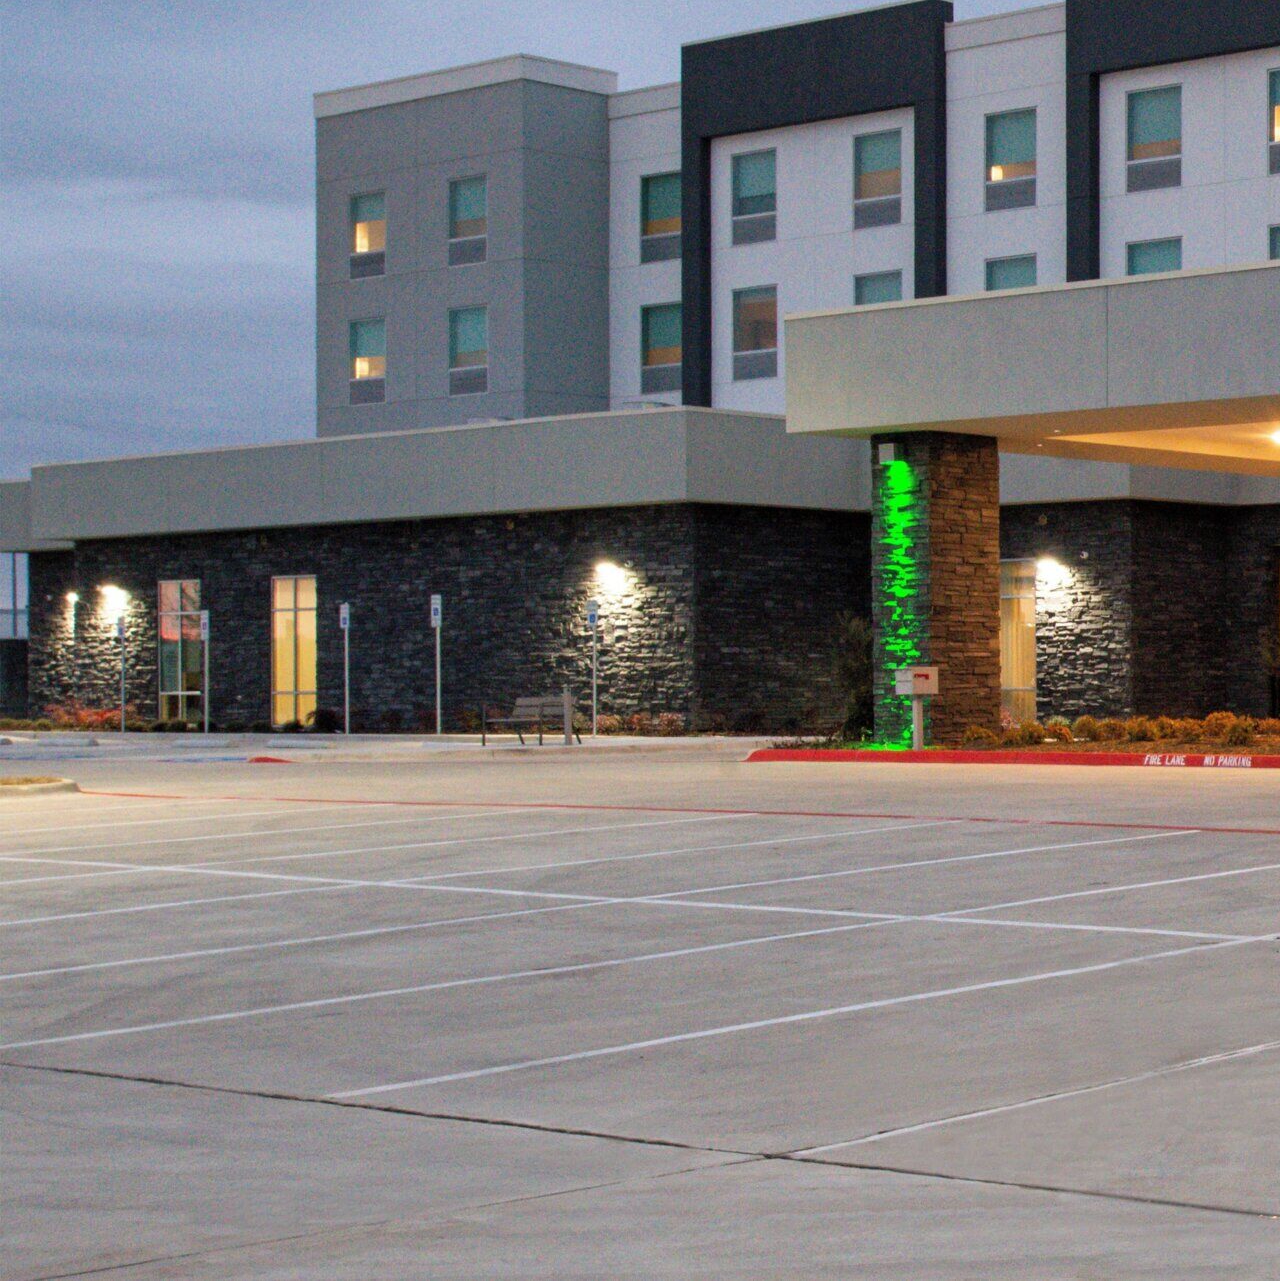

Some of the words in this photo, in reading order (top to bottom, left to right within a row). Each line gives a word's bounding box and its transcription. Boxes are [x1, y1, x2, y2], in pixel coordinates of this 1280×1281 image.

[1144, 754, 1163, 765] FIRE
[1165, 755, 1187, 766] LANE
[1203, 756, 1215, 766] NO
[1217, 756, 1252, 767] PARKING
